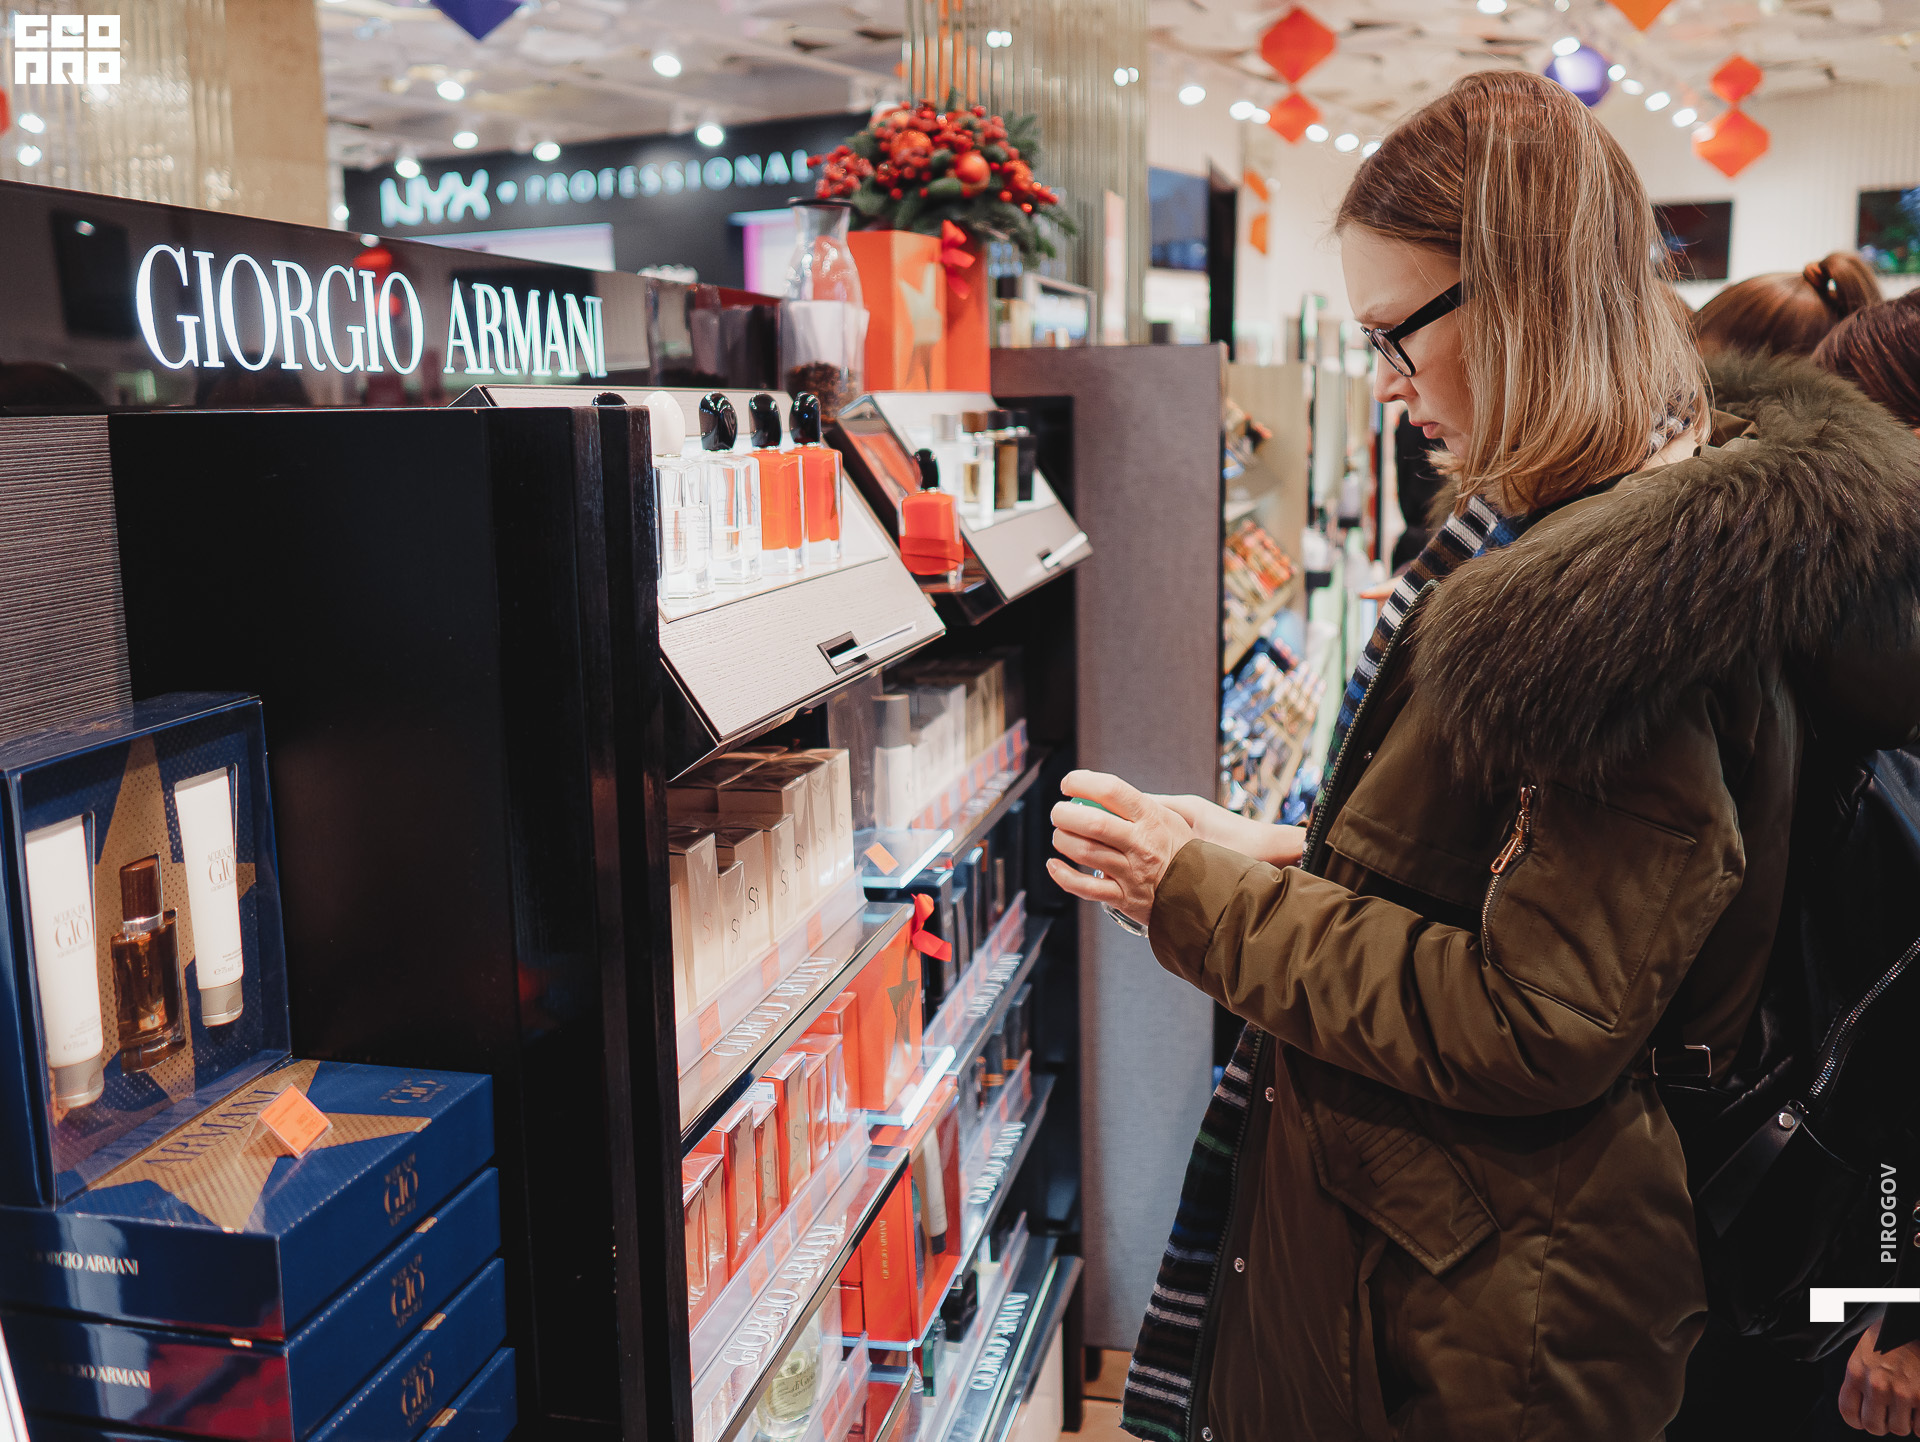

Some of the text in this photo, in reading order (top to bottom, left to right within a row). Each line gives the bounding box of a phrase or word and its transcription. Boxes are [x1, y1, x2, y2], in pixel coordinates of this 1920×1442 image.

[379, 149, 815, 228] NYX PROFESSIONAL
[135, 244, 608, 379] GIORGIO ARMANI
[710, 1002, 792, 1057] GIORGIO
[86, 1254, 139, 1276] ARMANI
[722, 1287, 799, 1366] GIORGIO
[98, 1365, 151, 1389] ARMANI
[969, 1336, 1011, 1391] GIORGIO
